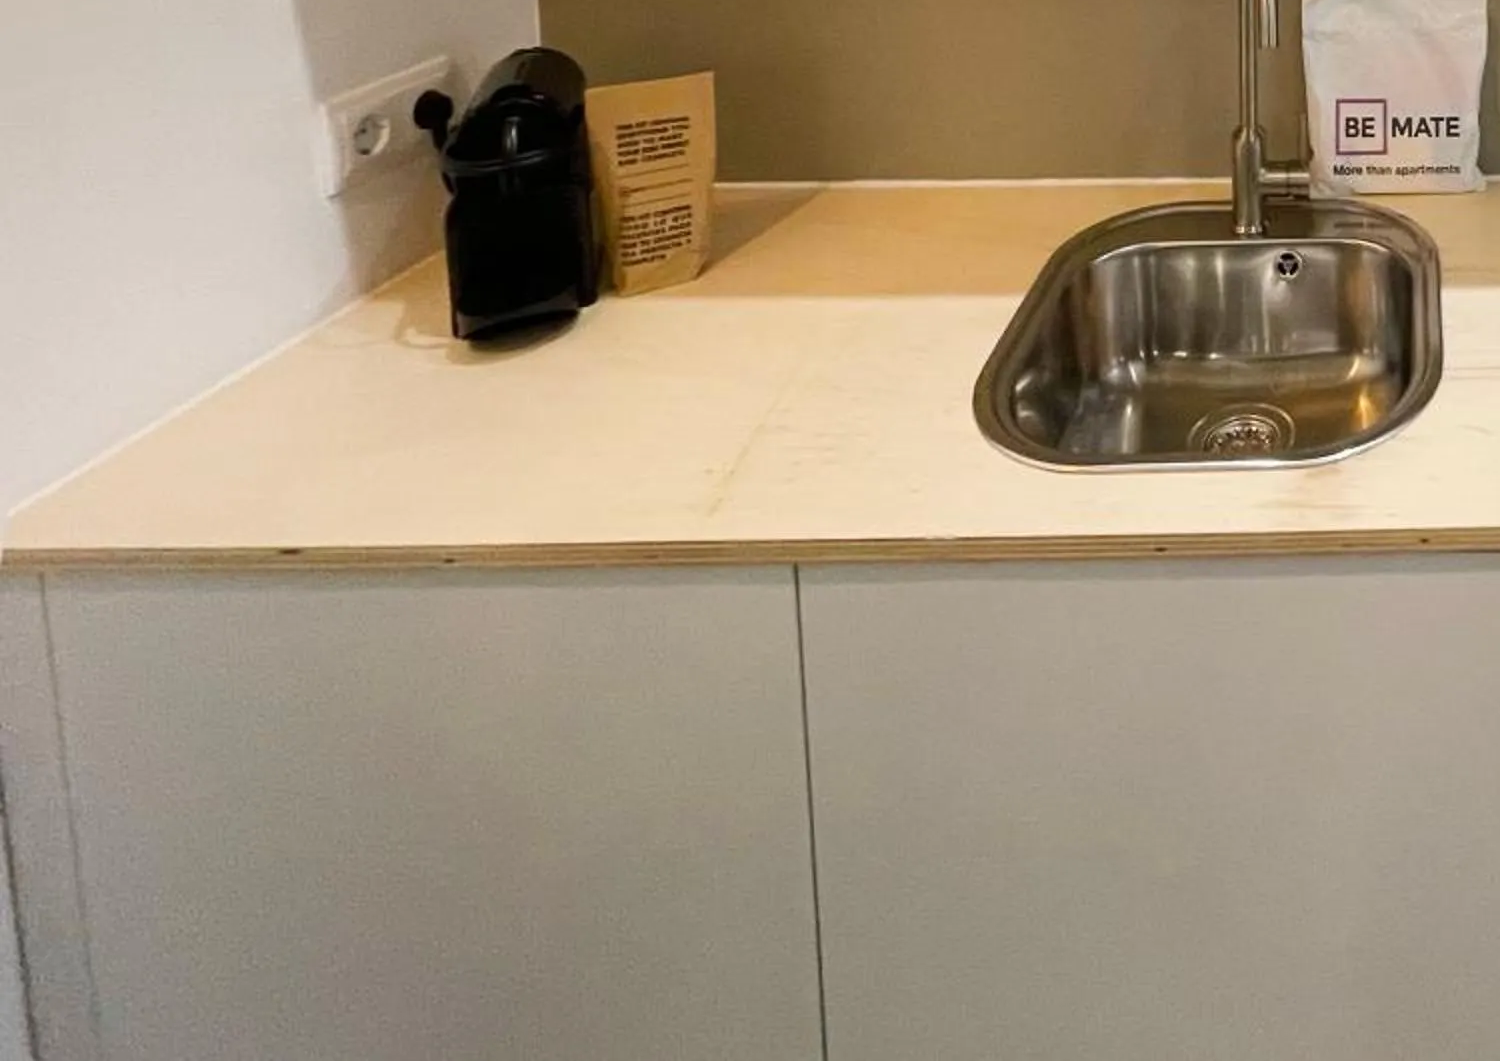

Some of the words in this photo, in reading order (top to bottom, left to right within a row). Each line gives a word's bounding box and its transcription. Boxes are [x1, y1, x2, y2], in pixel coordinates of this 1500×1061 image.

[1344, 117, 1375, 138] BE
[1391, 117, 1460, 138] MATE
[1333, 165, 1363, 176] More
[1366, 165, 1392, 175] than
[1395, 164, 1461, 177] apartments
